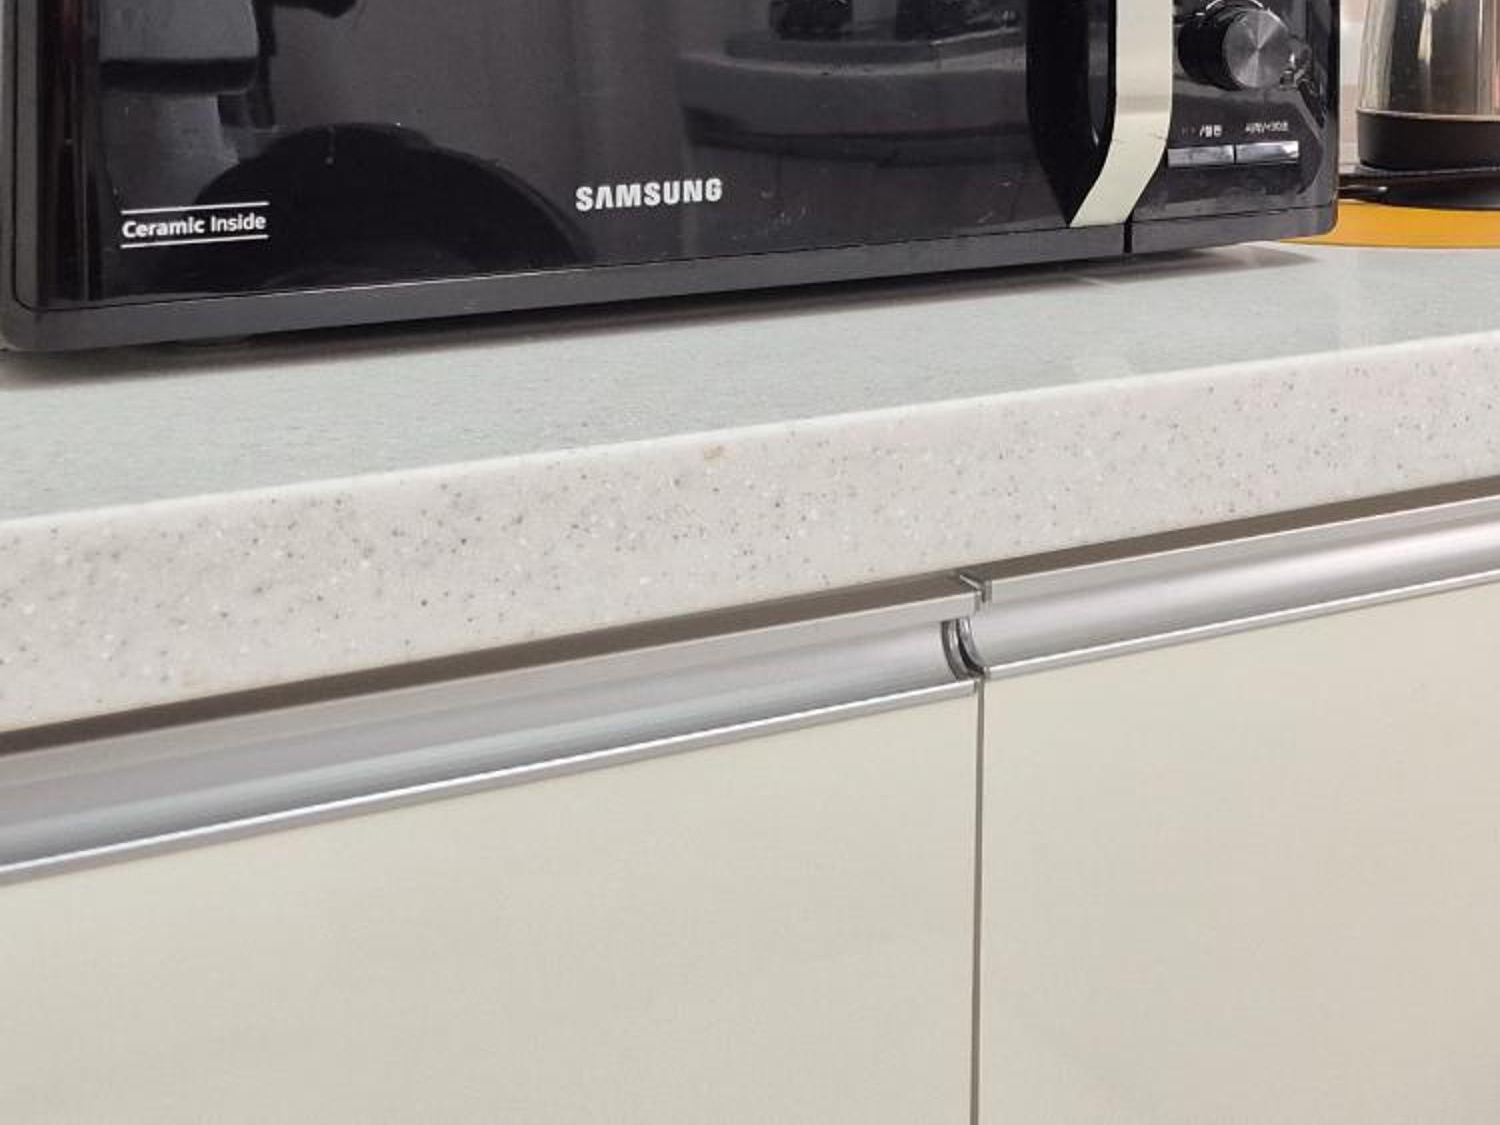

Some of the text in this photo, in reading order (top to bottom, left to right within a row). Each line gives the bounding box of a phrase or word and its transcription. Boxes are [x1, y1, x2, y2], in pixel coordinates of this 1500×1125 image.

[574, 177, 724, 212] SAMSUNG
[121, 212, 268, 239] Ceramic Inside
